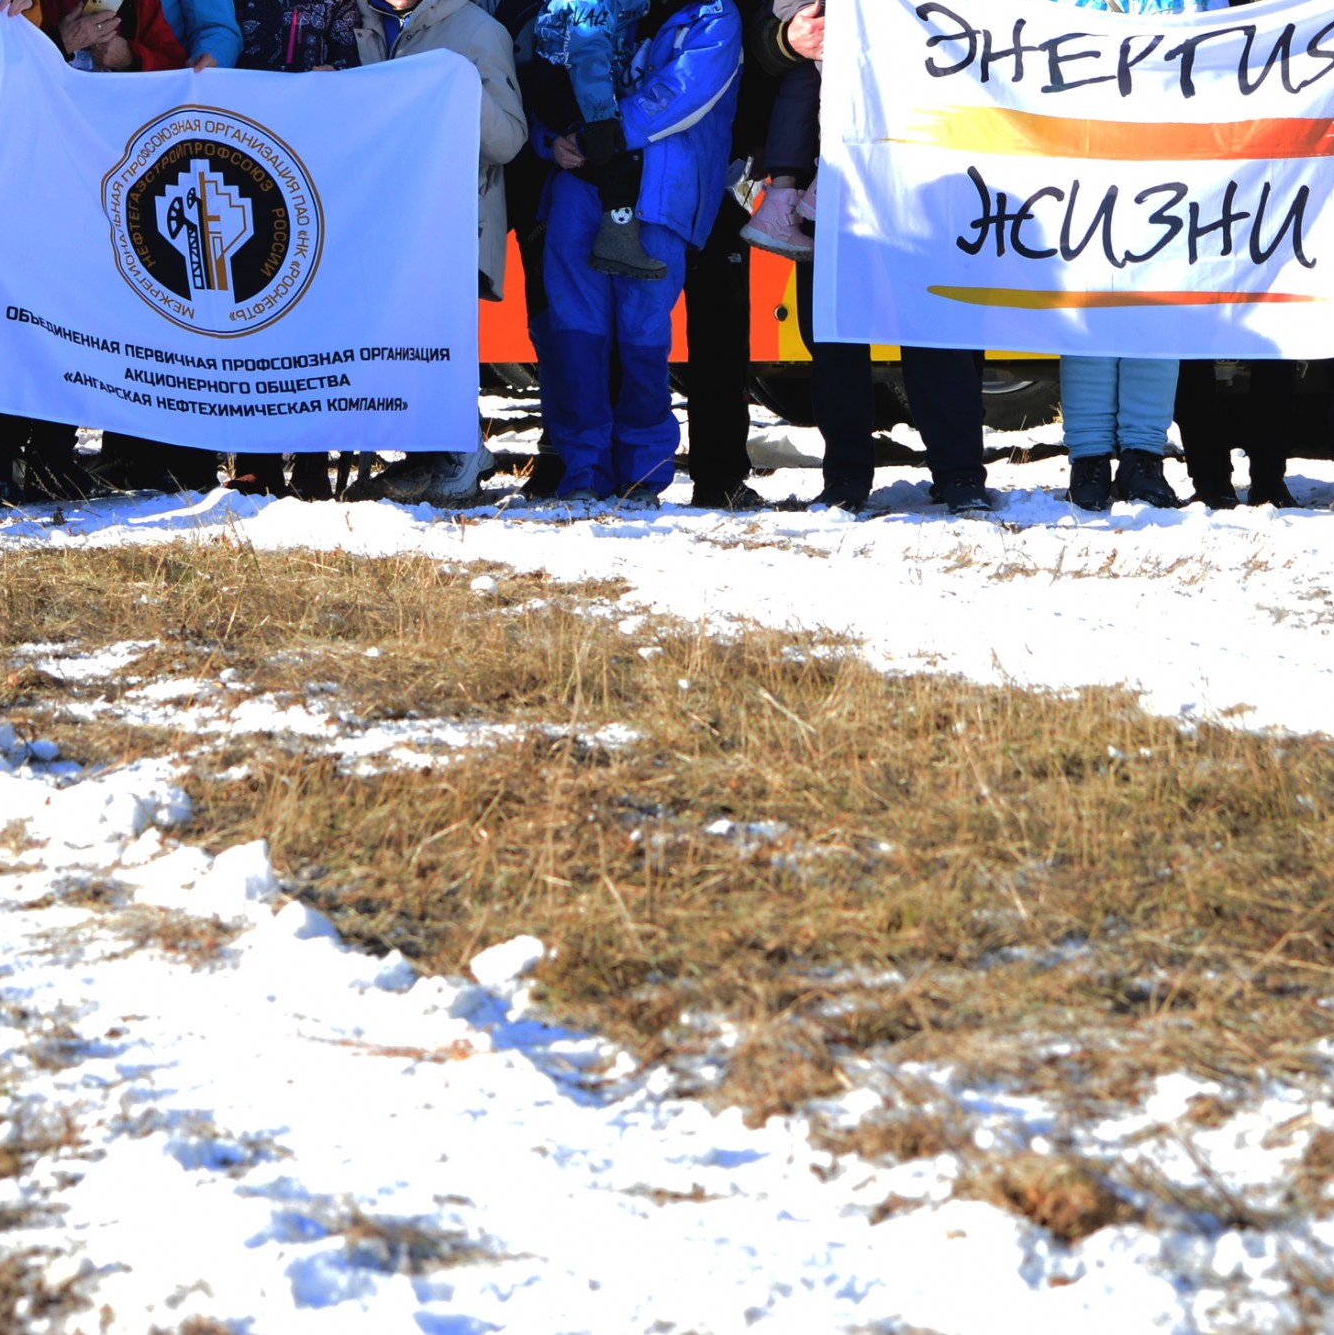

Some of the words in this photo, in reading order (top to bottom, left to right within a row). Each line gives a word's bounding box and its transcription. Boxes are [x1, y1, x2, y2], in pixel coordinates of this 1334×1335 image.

[121, 119, 201, 183] ПРОФСОЮЗНАЯ
[204, 120, 301, 194] ОРГАНИЗАЦИЯ
[128, 142, 274, 268] НЕФТЕГАЗСТРОЙПРОФСОЮЗ
[260, 207, 287, 278] РОССИИ
[291, 194, 311, 226] ПАО
[955, 165, 1318, 269] ЖИЗНИ
[110, 180, 195, 320] МЕЖРЕГИОНАЛЬНАЯ
[293, 229, 310, 260] «НК
[229, 260, 301, 322] «РОСНЕФТЬ»
[5, 305, 121, 355] ОБЪЕДИНЕННАЯ
[124, 343, 218, 372] ПЕРВИЧНАЯ
[221, 349, 355, 372] ПРОФСОЮЗНАЯ
[359, 347, 451, 364] ОРГАНИЗАЦИЯ
[63, 371, 153, 407] «АНГАРСКАЯ
[156, 396, 323, 417] НЕФТЕХИМИЧЕСКАЯ
[326, 397, 409, 412] КОМПАНИЯ»
[124, 367, 251, 395] АКЦИОНЕРНОГО
[255, 373, 352, 394] ОБЩЕСТВА
